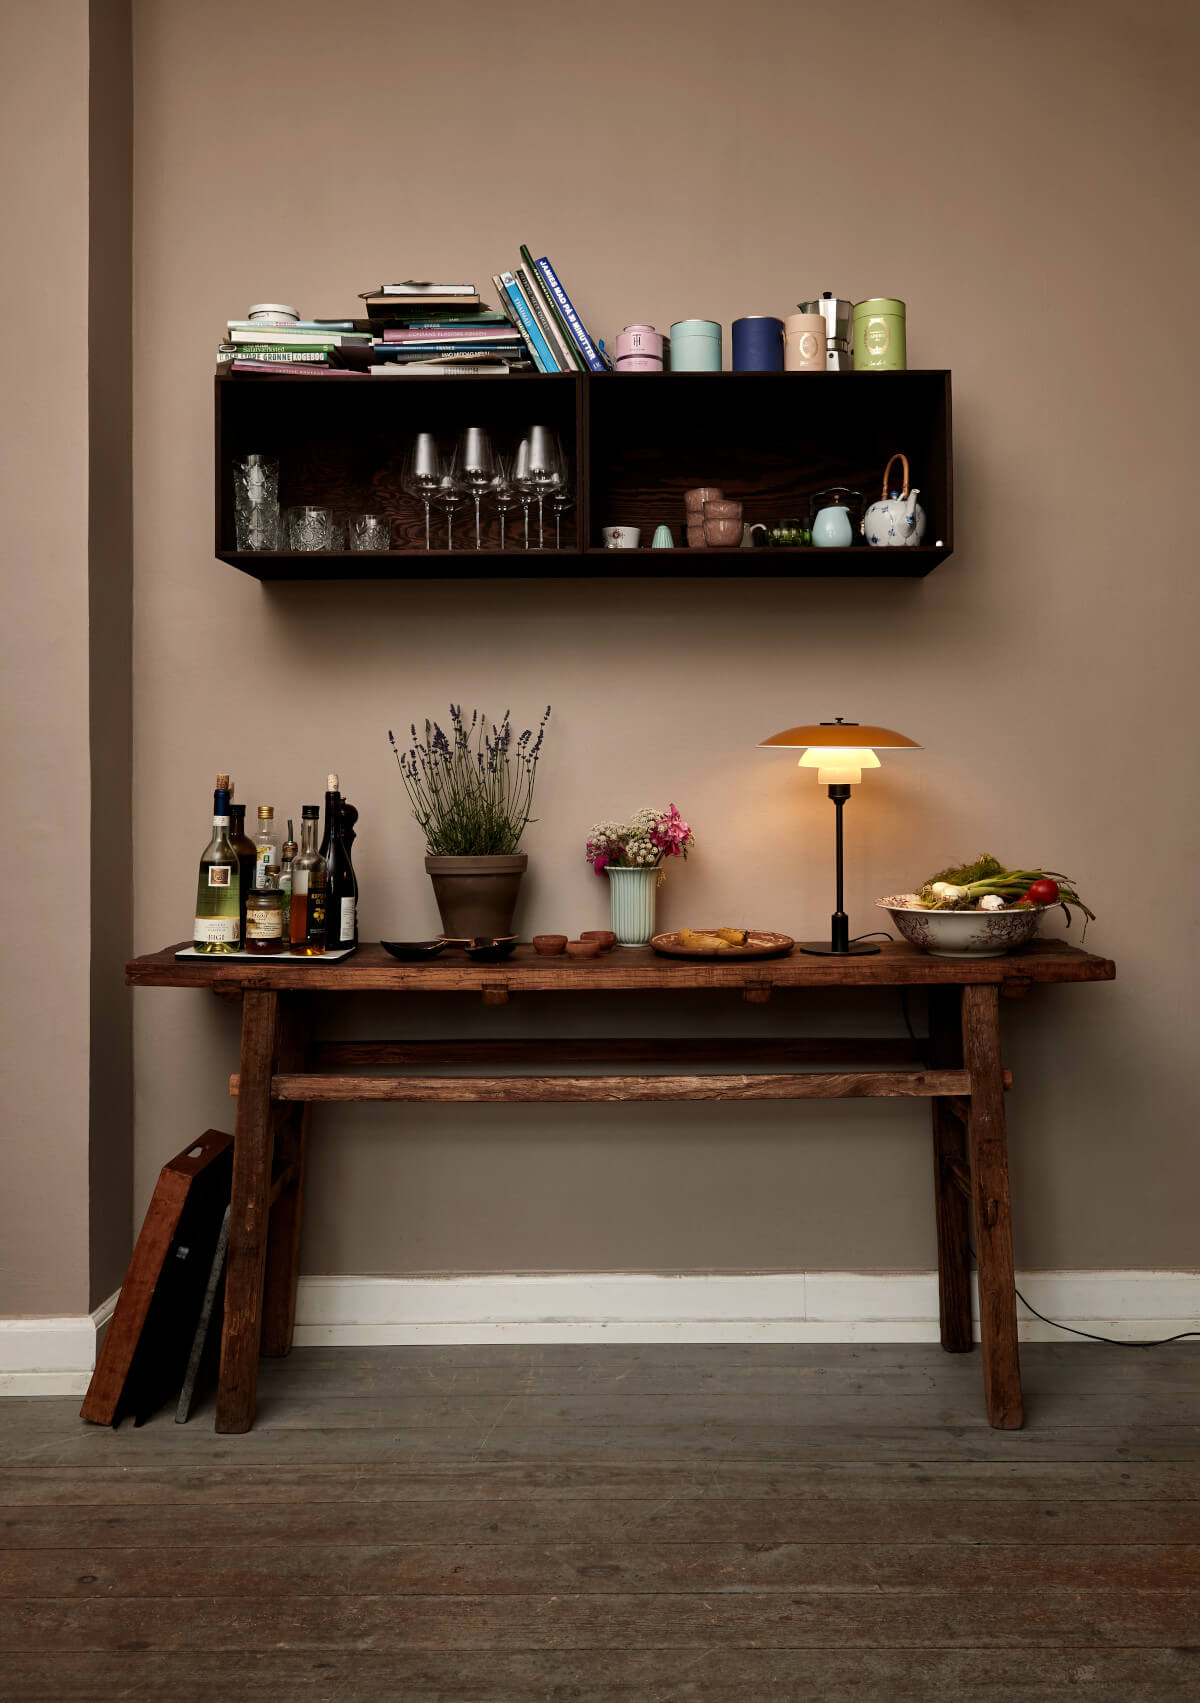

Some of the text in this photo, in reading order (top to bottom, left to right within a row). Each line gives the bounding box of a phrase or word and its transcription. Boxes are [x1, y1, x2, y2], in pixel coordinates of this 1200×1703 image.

[539, 260, 558, 288] JAMIES
[553, 287, 567, 307] MAD
[562, 302, 574, 316] PÅ
[570, 319, 597, 361] MINUTTER
[262, 353, 291, 361] GRØNNE
